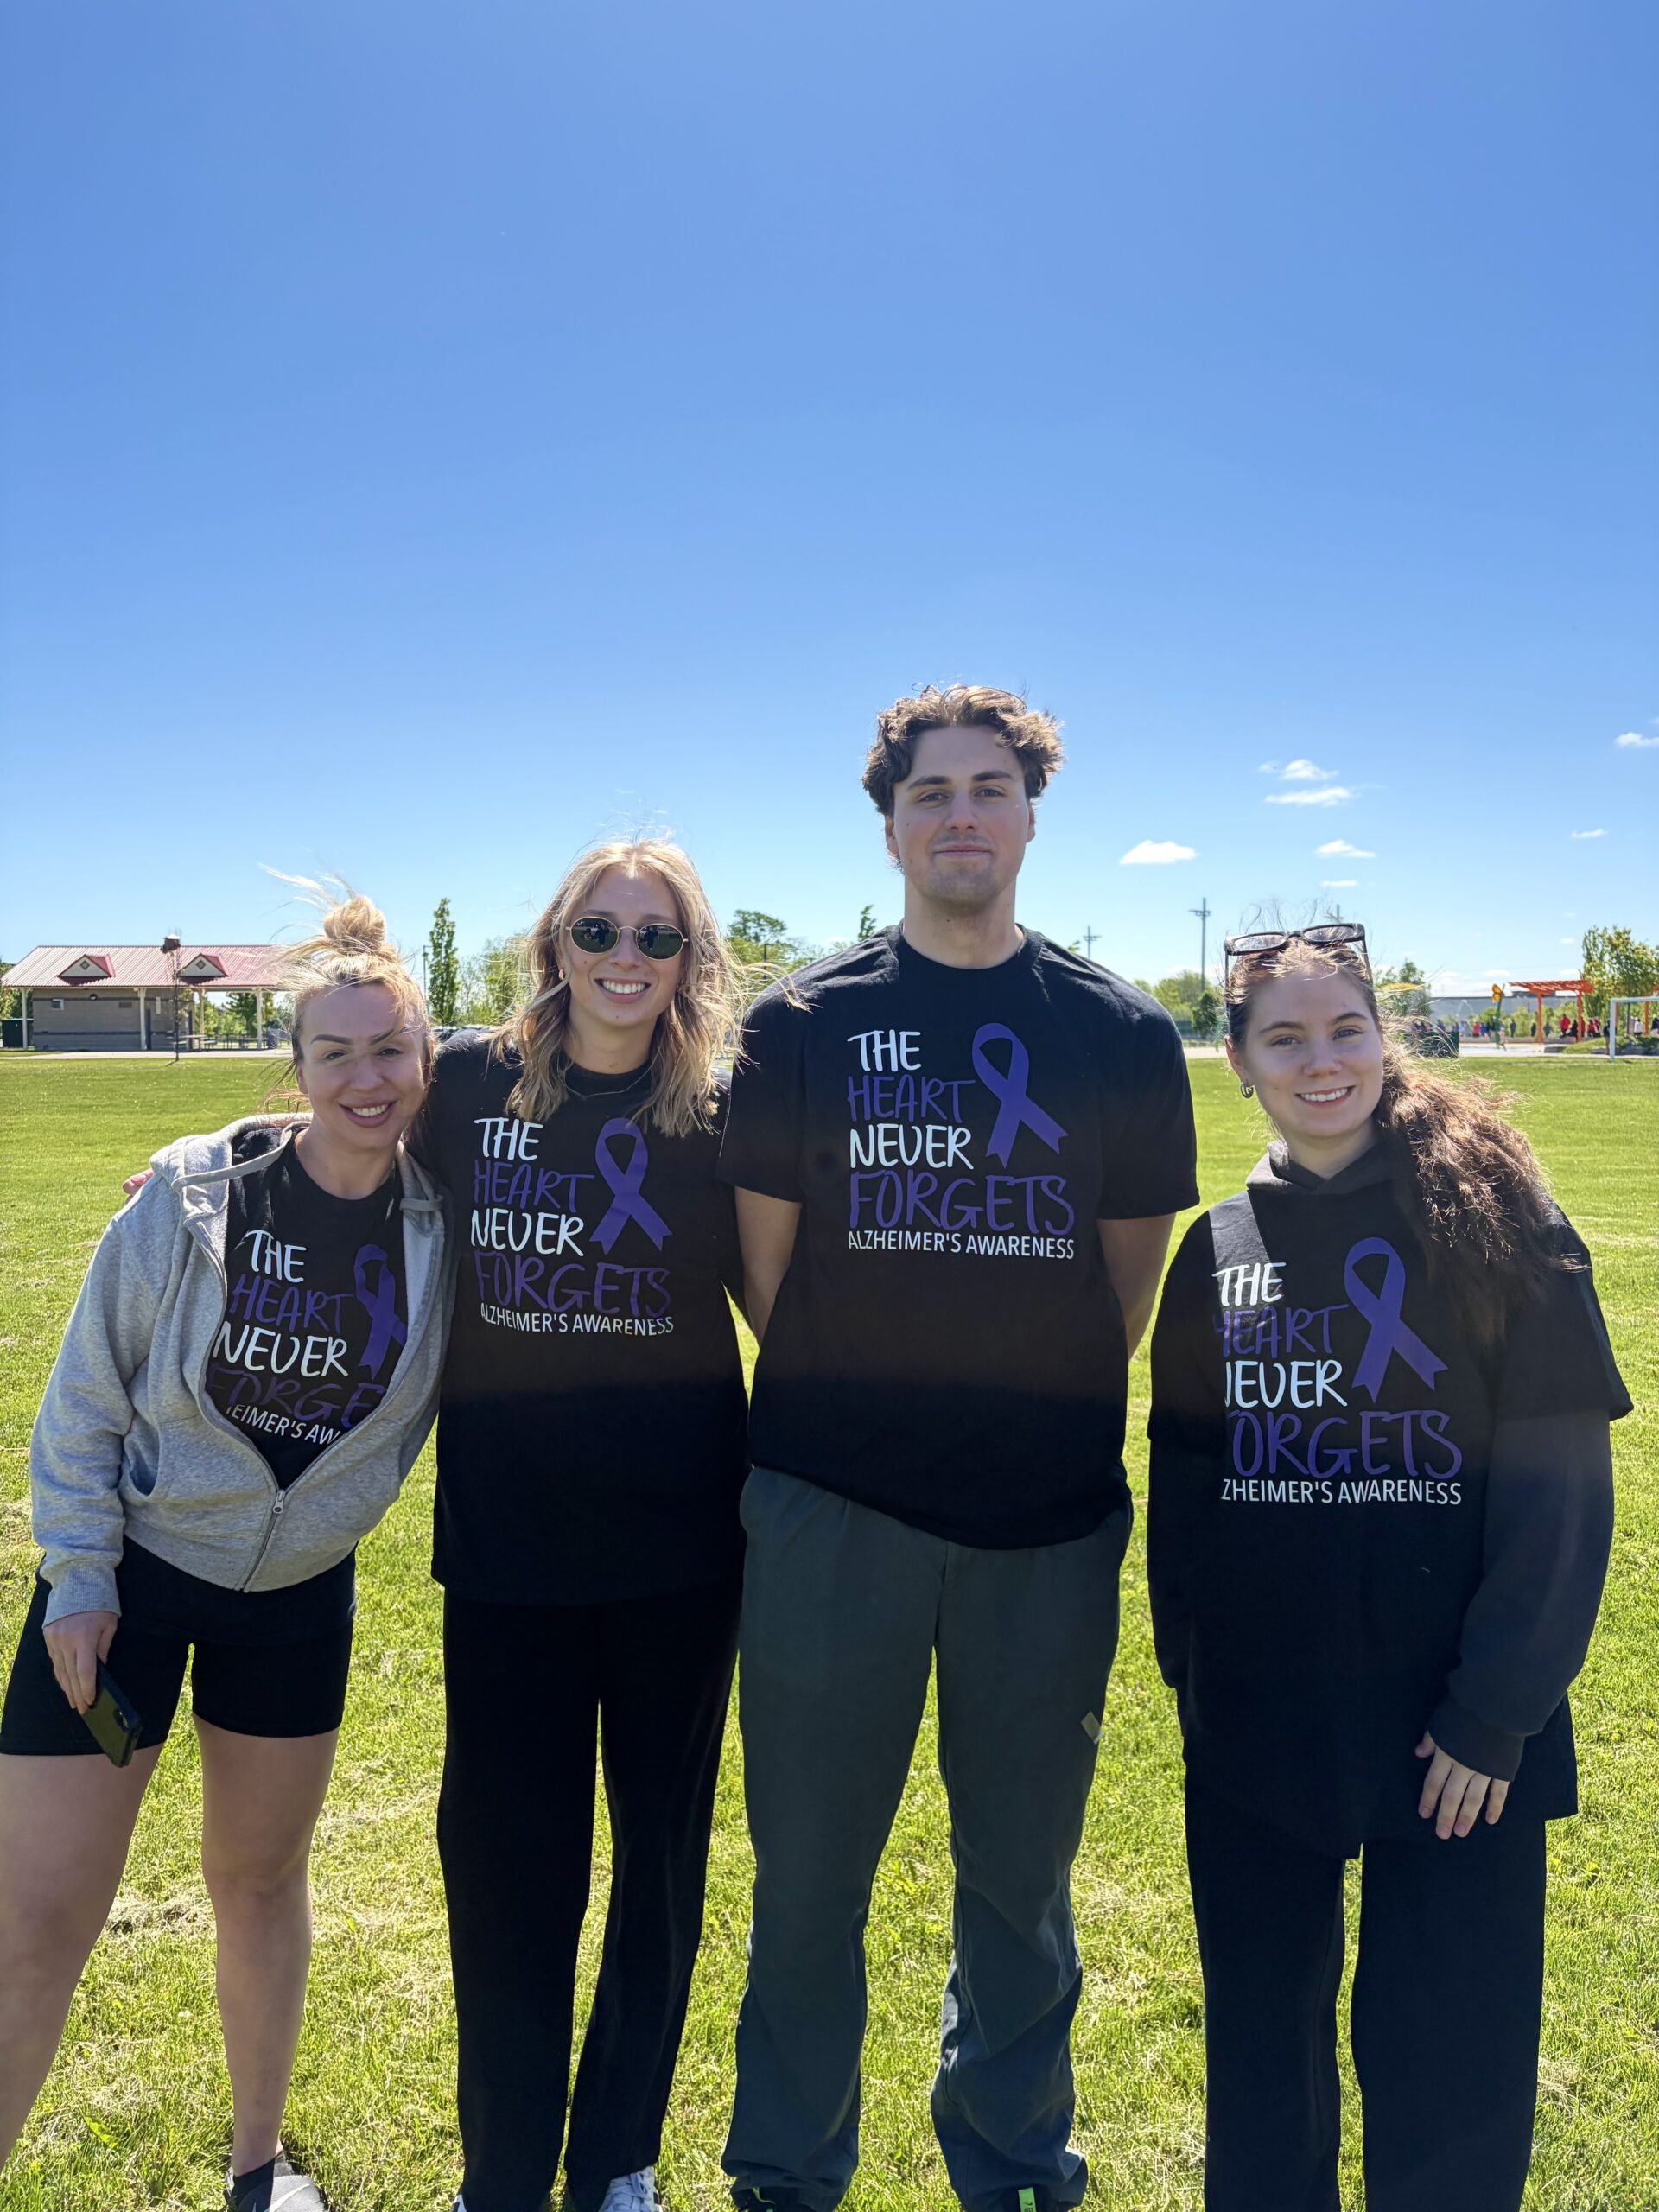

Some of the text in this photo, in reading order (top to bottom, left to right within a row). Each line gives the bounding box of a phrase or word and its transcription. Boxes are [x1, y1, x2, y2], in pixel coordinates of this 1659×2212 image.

[847, 1029, 921, 1071] THE
[847, 1074, 976, 1123] HEART
[474, 1117, 543, 1160] THE
[849, 1123, 974, 1169] NEVER
[474, 1159, 594, 1213] HEART
[849, 1169, 1074, 1235] FORGETS
[244, 1230, 307, 1282] THE
[470, 1208, 584, 1256] NEVER
[848, 1230, 1074, 1259] ALZHEIMER'S AWARENESS
[229, 1274, 353, 1333] HEART
[475, 1250, 671, 1318] FORGETS
[1211, 1262, 1287, 1307] THE
[480, 1303, 674, 1336] ALZHEIMER'S AWARENESS
[213, 1320, 348, 1377] NEVER
[207, 1363, 387, 1429] FORGE
[226, 1403, 308, 1439] EIMER'S
[1225, 1410, 1463, 1479] ORGETS
[1220, 1478, 1462, 1505] ZHEIMER'S AWARENESS
